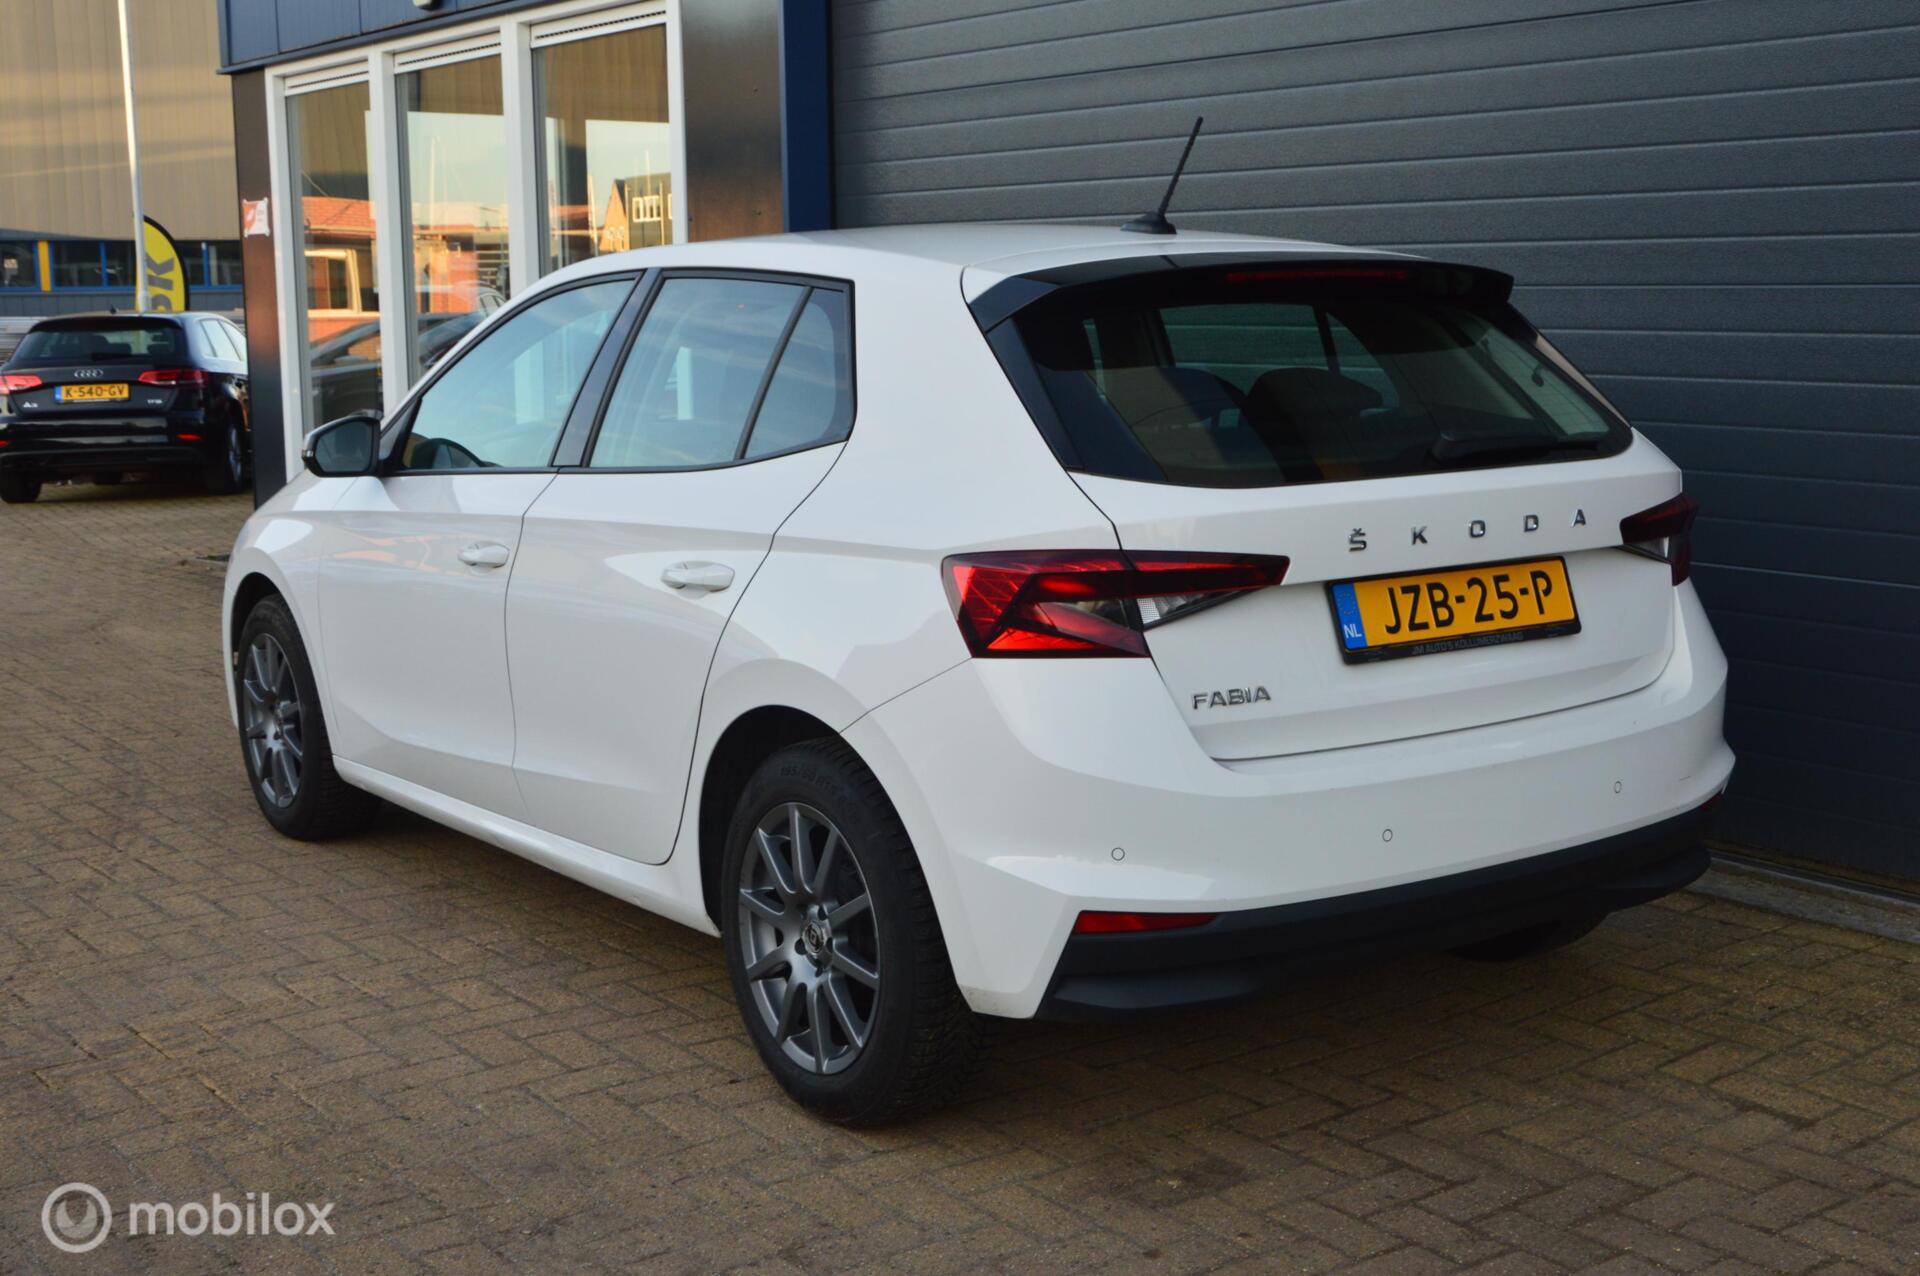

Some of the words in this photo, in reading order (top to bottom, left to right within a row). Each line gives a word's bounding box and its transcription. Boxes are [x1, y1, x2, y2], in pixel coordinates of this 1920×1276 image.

[1349, 508, 1587, 552] ŠKODA
[1385, 569, 1552, 634] JZB-25-P
[1343, 623, 1362, 638] NL
[1193, 686, 1271, 710] FABIA
